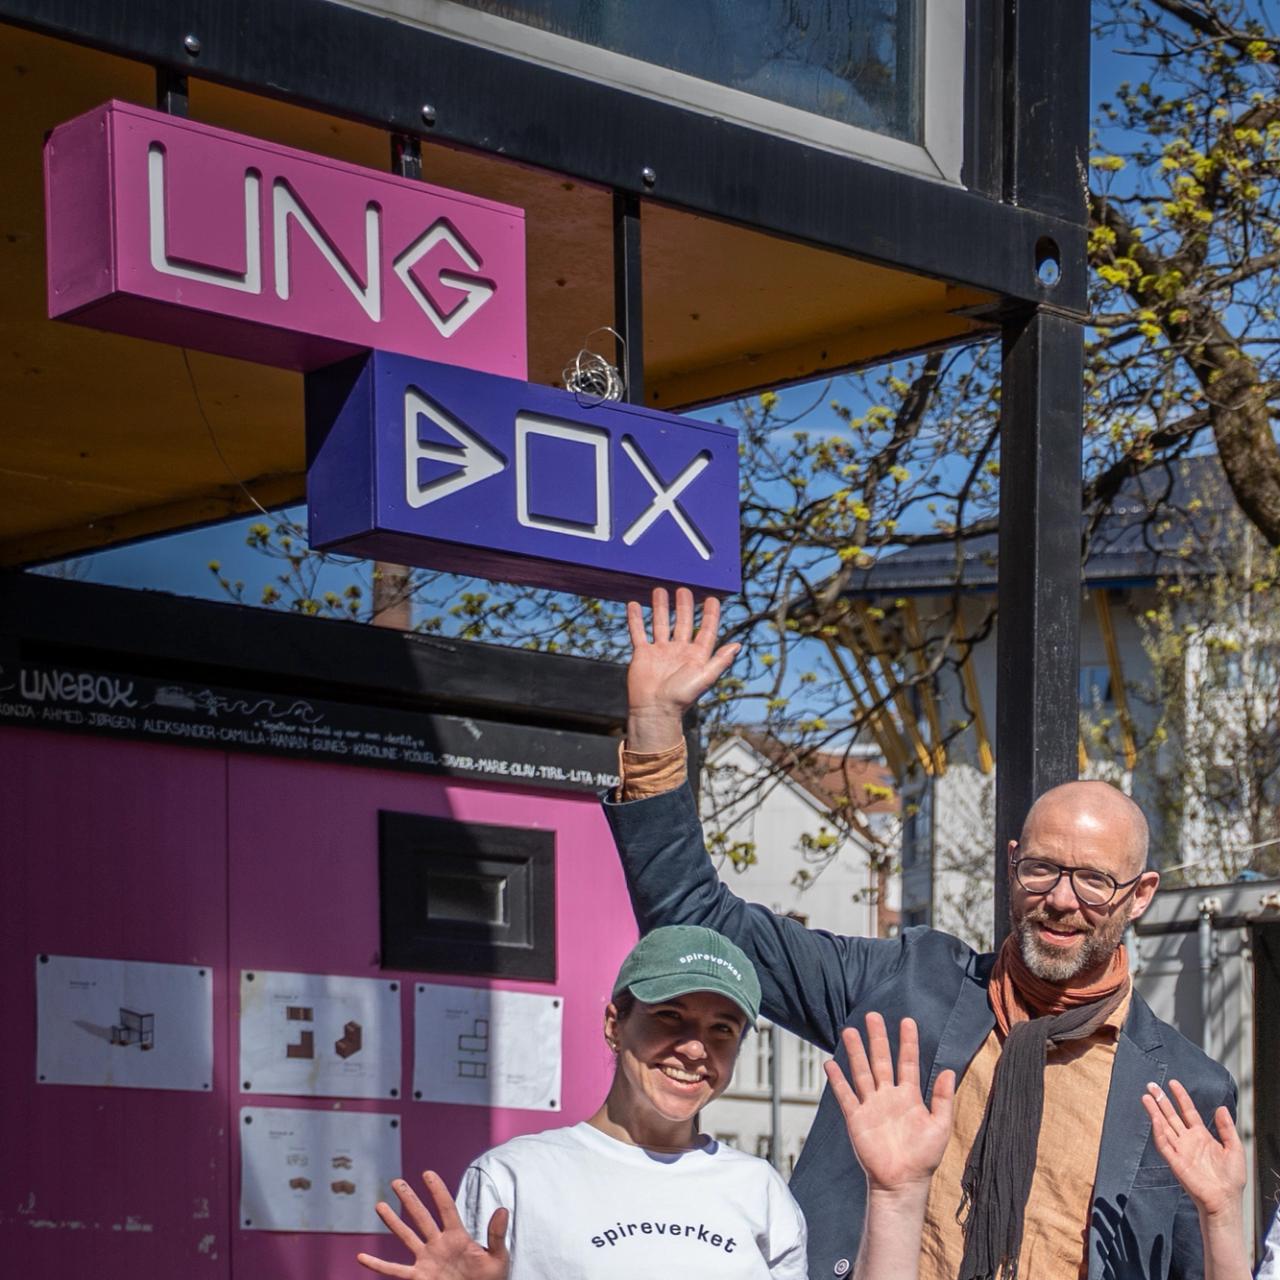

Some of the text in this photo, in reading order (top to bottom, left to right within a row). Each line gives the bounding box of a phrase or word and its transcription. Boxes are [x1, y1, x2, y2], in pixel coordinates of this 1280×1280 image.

[148, 141, 497, 338] UNG
[405, 386, 712, 559] BOX
[20, 669, 138, 708] UNGBOX
[42, 706, 83, 725] AHMED
[88, 711, 136, 730] JØRGEN
[220, 727, 265, 745] CAMILLA
[679, 953, 742, 982] spireverket
[591, 1221, 738, 1254] spireverket
